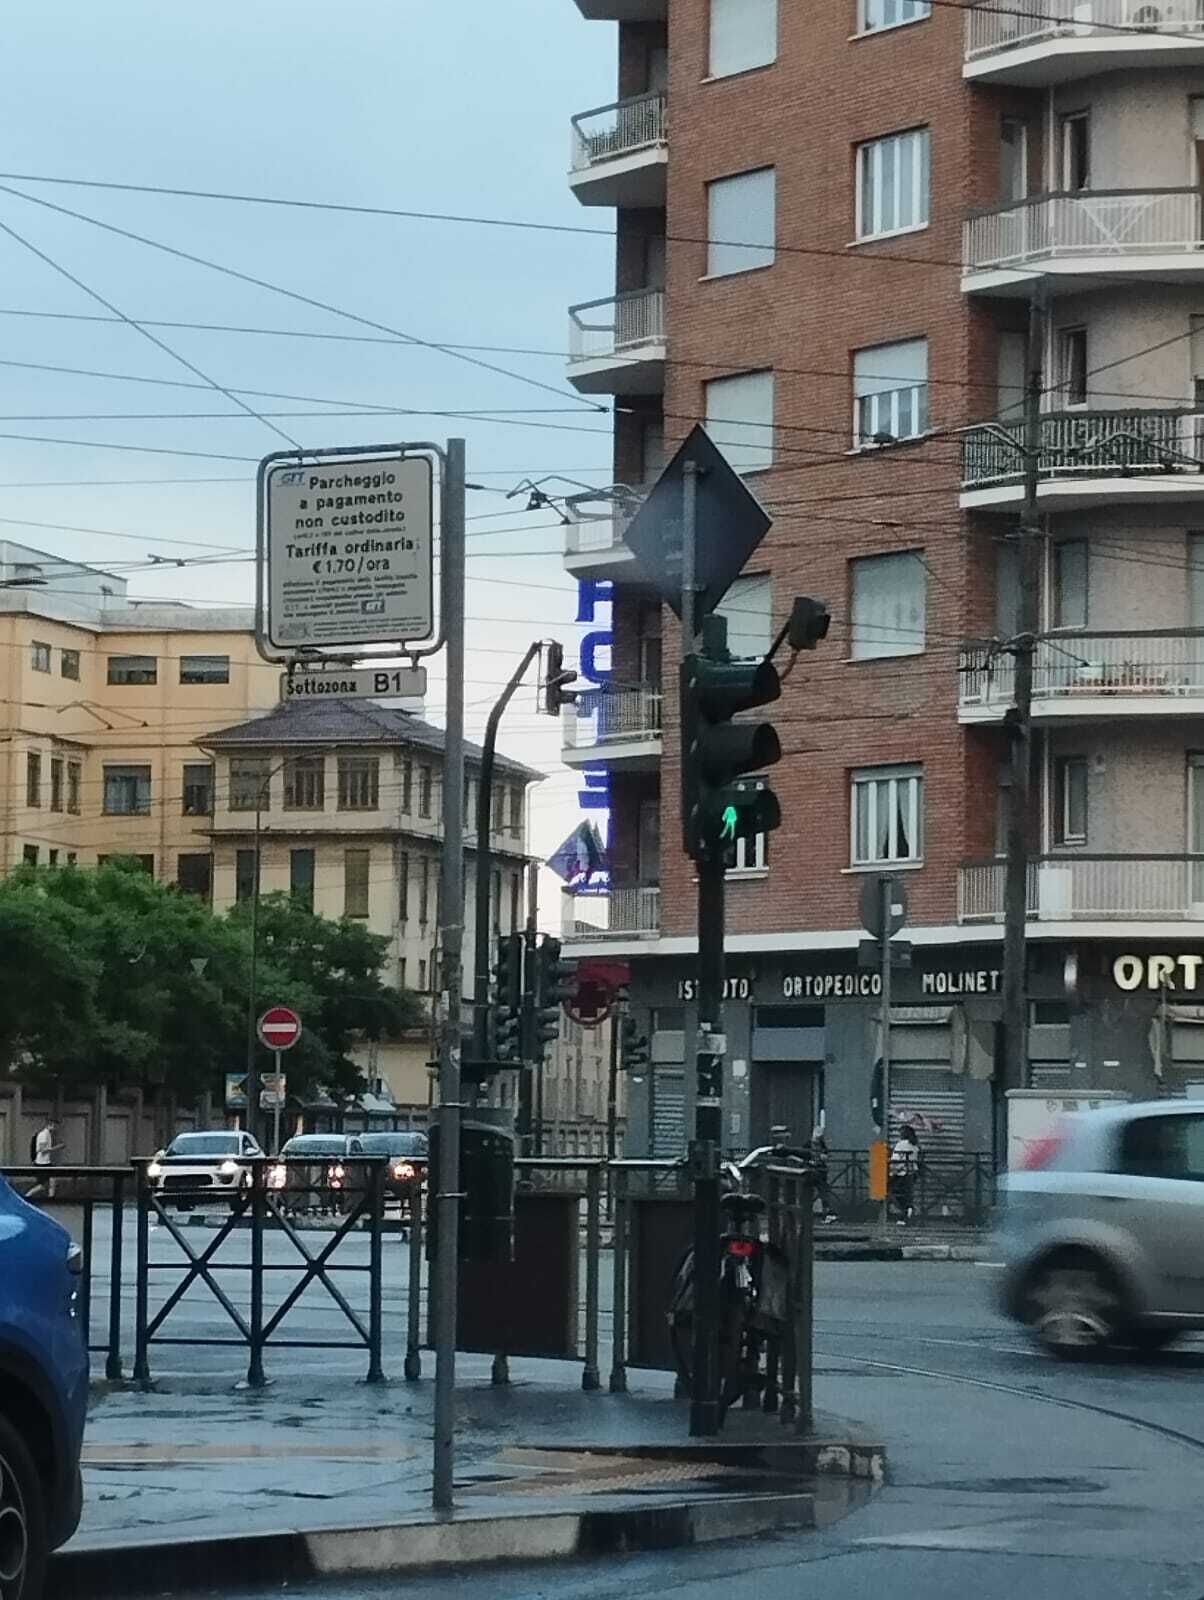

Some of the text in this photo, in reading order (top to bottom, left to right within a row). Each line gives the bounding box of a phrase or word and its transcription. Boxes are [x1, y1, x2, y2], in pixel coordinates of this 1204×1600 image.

[309, 471, 396, 490] Parcheggio
[299, 490, 403, 511] a pagamento
[295, 508, 405, 529] non custodito
[286, 541, 338, 559] Tariffa
[374, 672, 401, 693] B1
[1112, 954, 1203, 991] ORT
[783, 974, 882, 997] ORTOPEDICO
